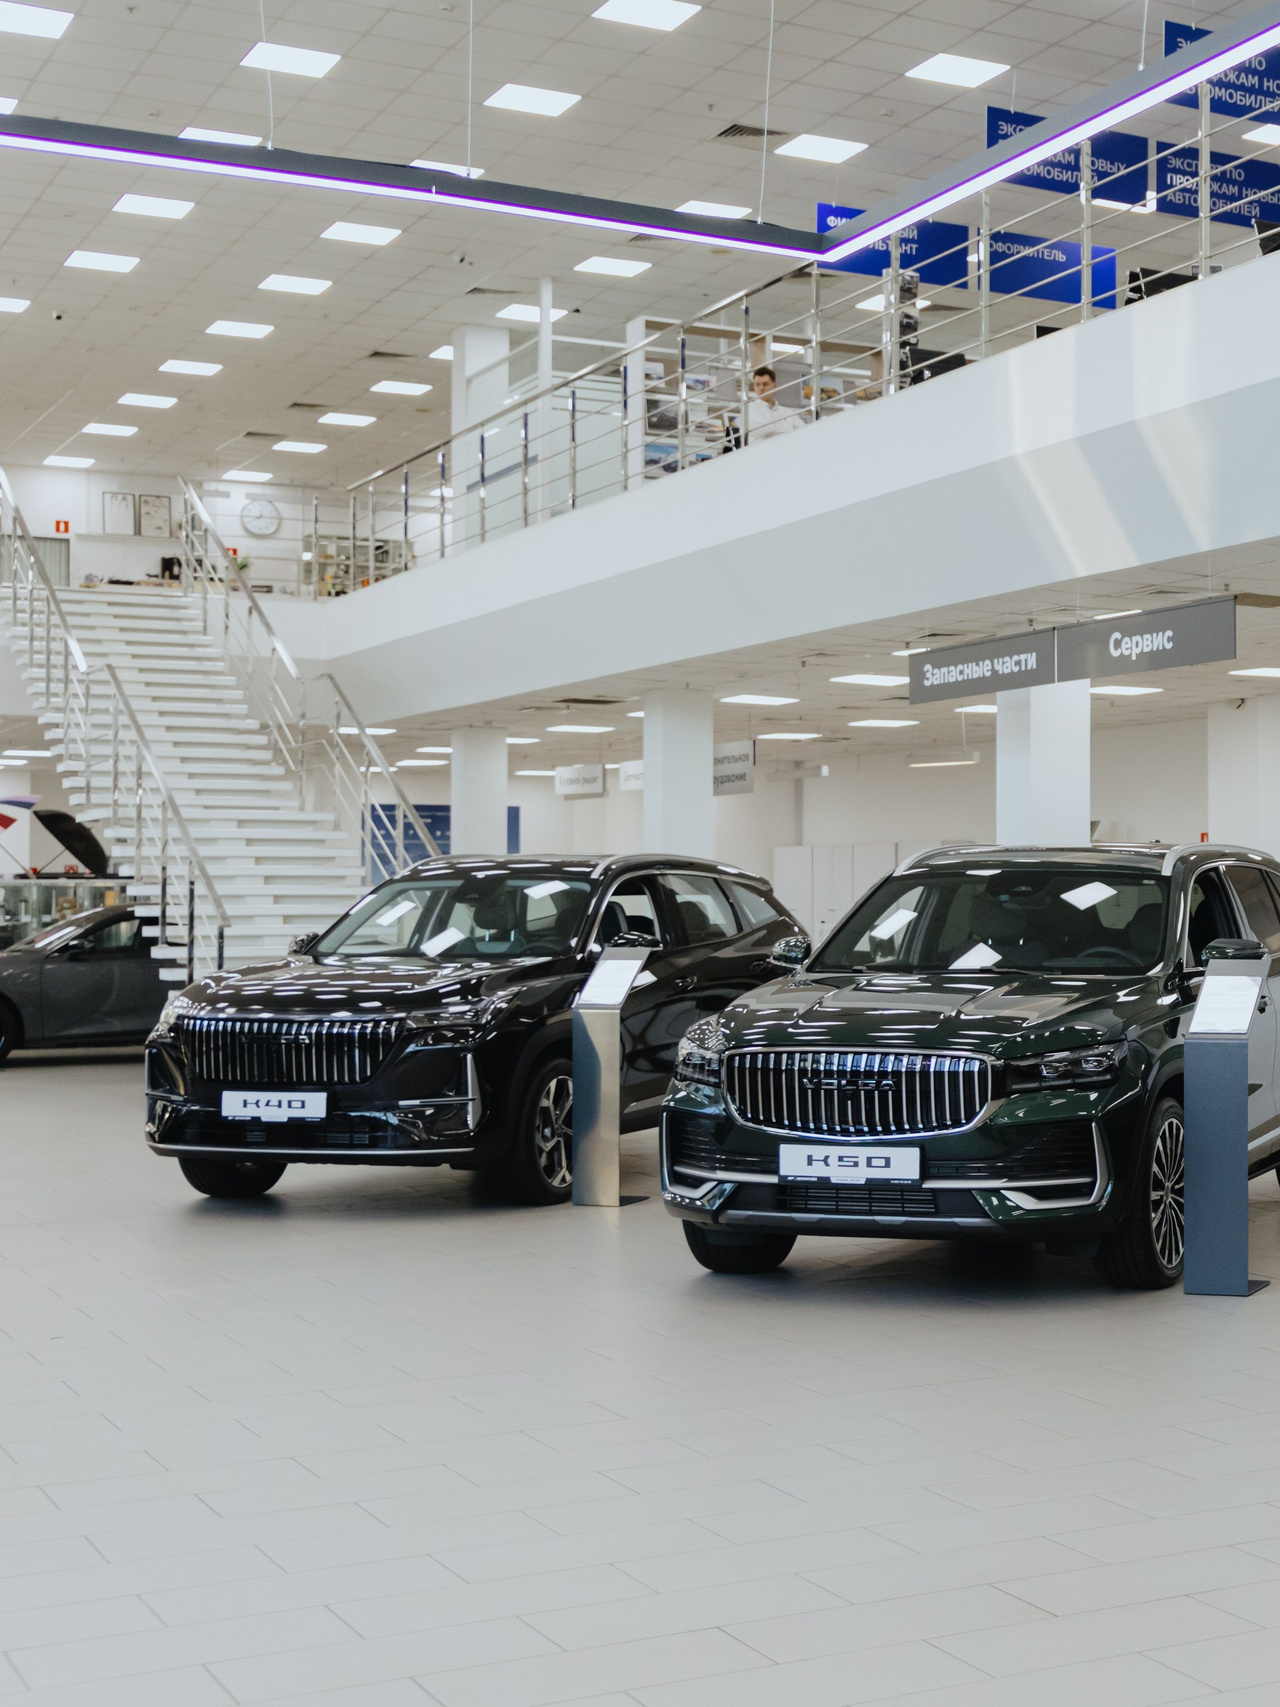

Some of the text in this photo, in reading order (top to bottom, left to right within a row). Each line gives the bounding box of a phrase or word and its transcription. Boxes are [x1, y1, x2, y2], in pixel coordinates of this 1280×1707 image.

[1227, 168, 1245, 181] ПО
[1109, 629, 1174, 660] Сервис
[923, 651, 1037, 687] Запасные части
[802, 1078, 896, 1090] VOLGA
[243, 1099, 305, 1109] K40
[806, 1154, 891, 1168] K50
